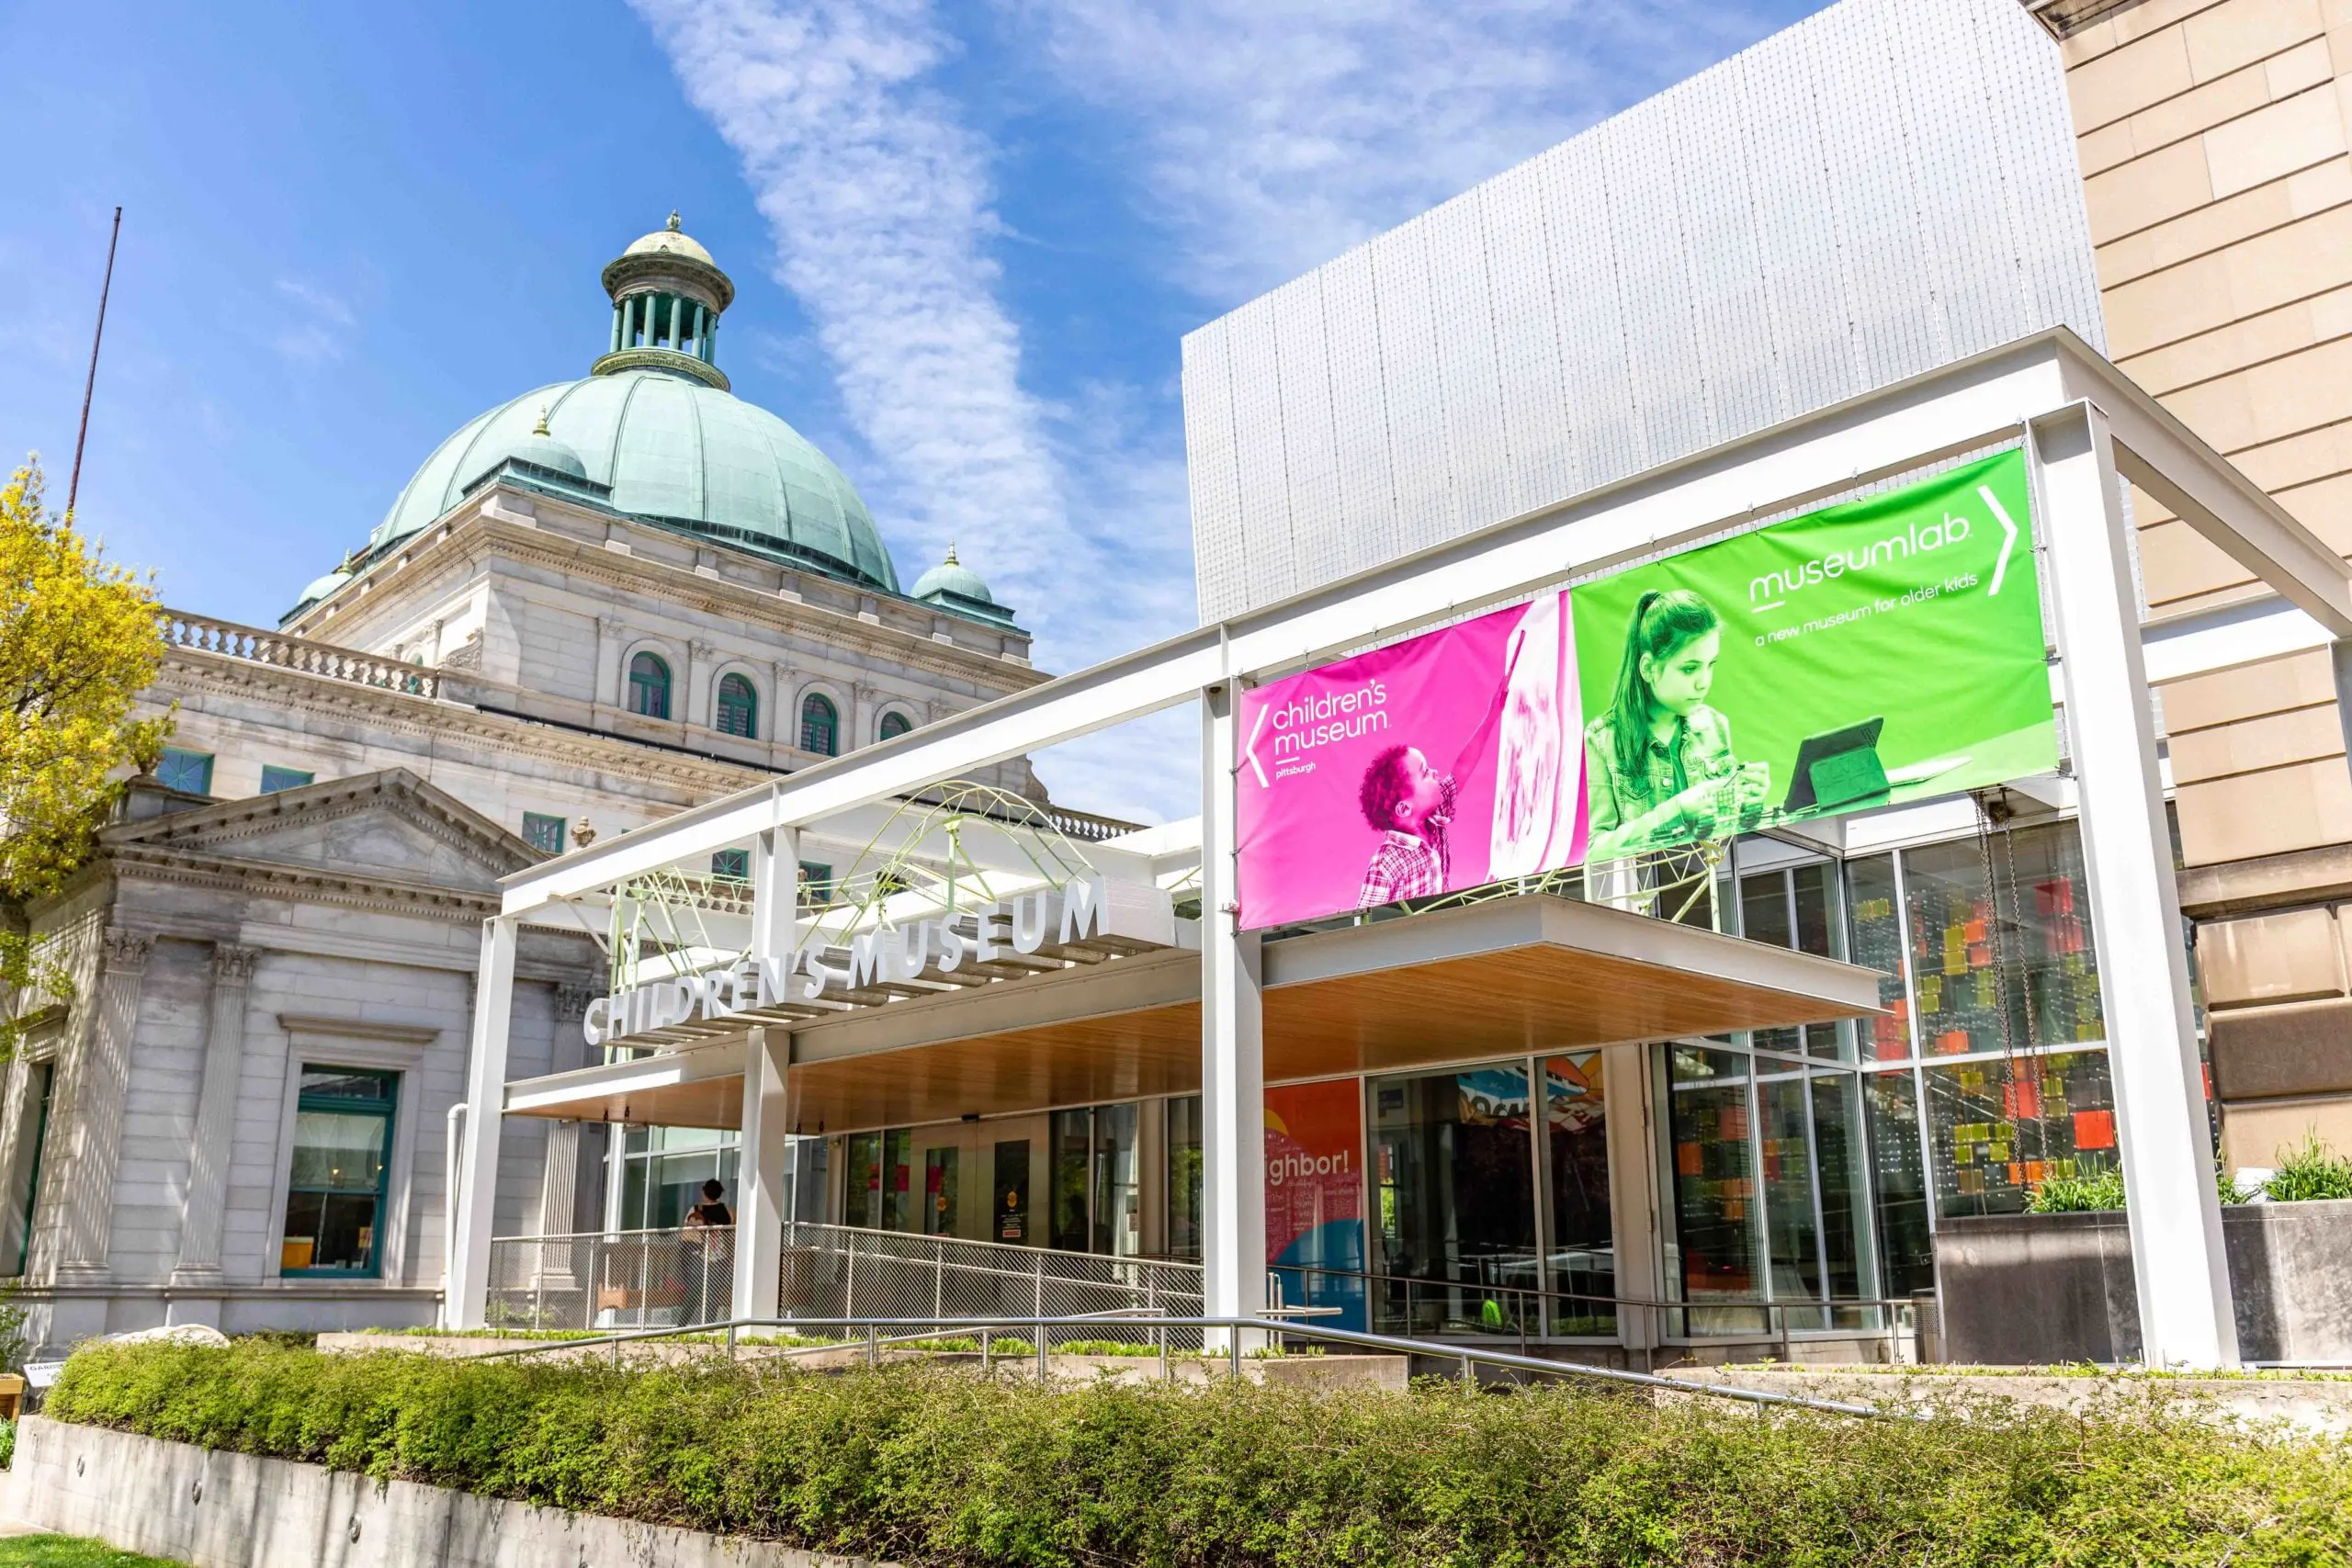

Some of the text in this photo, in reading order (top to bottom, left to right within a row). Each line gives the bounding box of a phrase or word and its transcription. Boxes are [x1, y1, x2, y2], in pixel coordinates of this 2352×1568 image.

[1749, 512, 1971, 603] museumlab
[1754, 571, 1978, 647] a new museum for older kids
[1272, 678, 1387, 730] children's
[1274, 710, 1388, 756] museum
[1275, 761, 1317, 781] pittsburgh
[582, 875, 1110, 1045] CHILDREN'S MUSEUM
